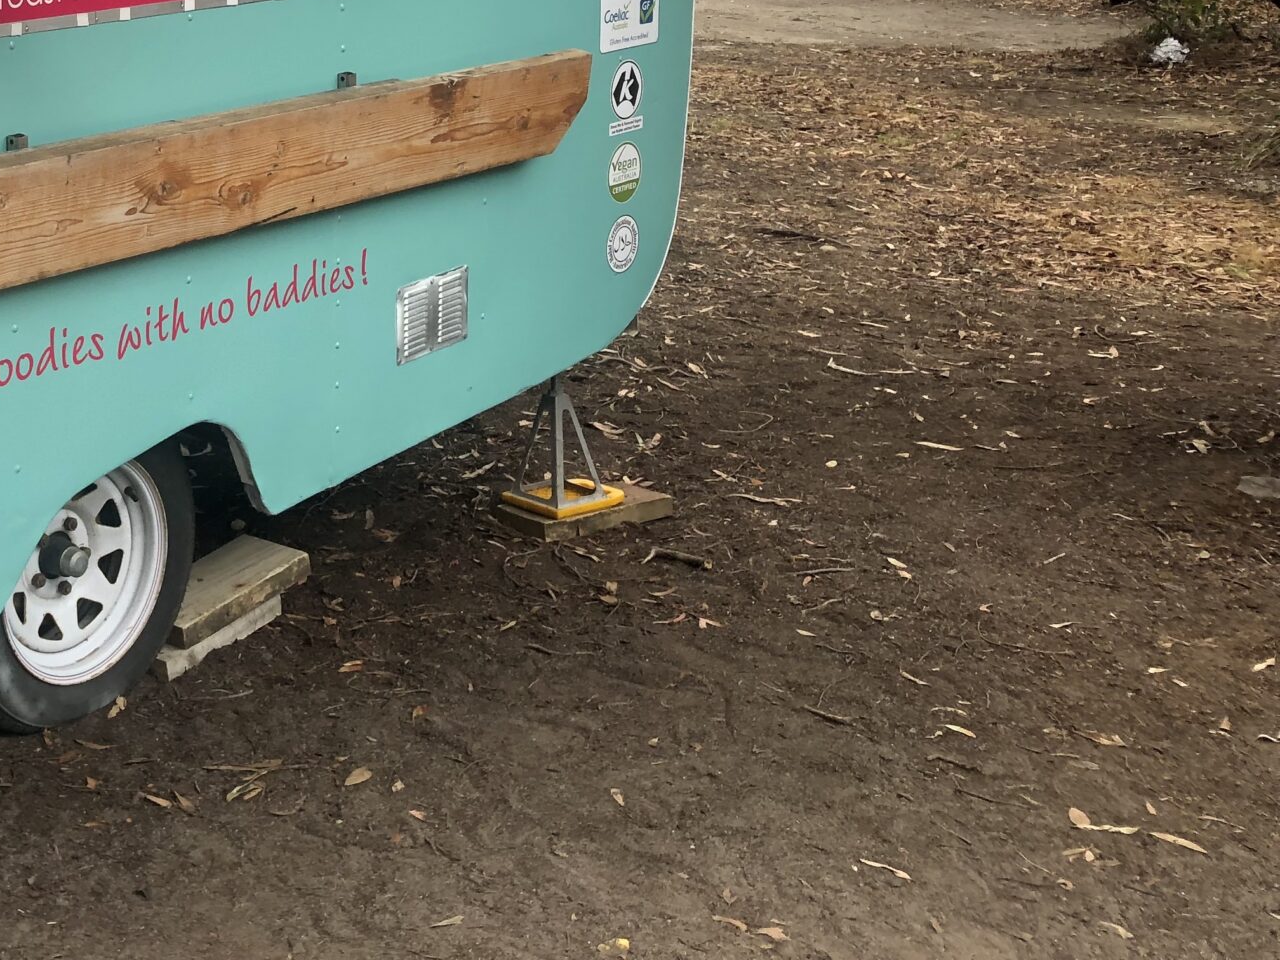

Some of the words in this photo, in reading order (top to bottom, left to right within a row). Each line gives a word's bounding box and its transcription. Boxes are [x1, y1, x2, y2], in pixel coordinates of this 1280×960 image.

[612, 156, 638, 173] Vegan
[612, 181, 637, 195] CERTIFIED
[116, 297, 190, 360] with
[199, 296, 235, 330] no
[246, 247, 370, 317] baddies!
